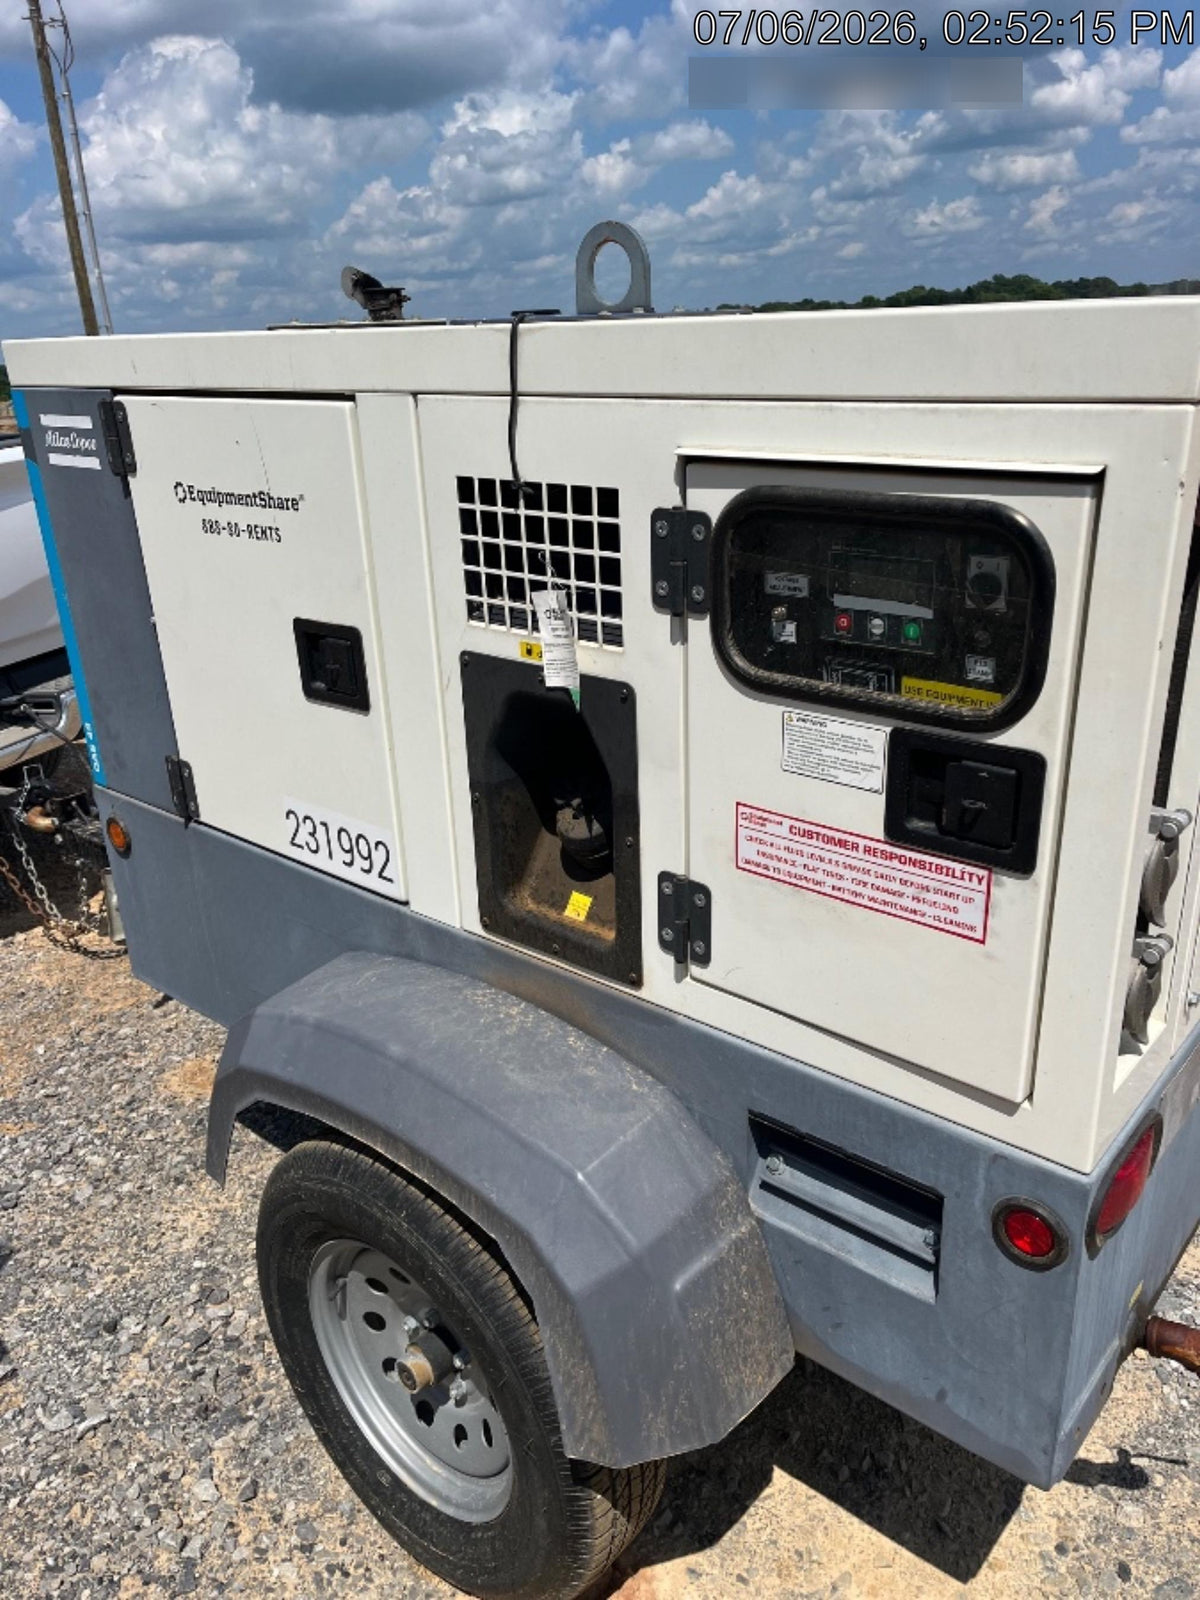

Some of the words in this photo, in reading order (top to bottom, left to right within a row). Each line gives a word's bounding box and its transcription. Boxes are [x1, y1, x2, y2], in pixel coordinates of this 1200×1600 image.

[285, 808, 395, 885] 231992
[788, 824, 860, 853] CUSTOMER
[863, 844, 986, 886] RESPONSIBILITY
